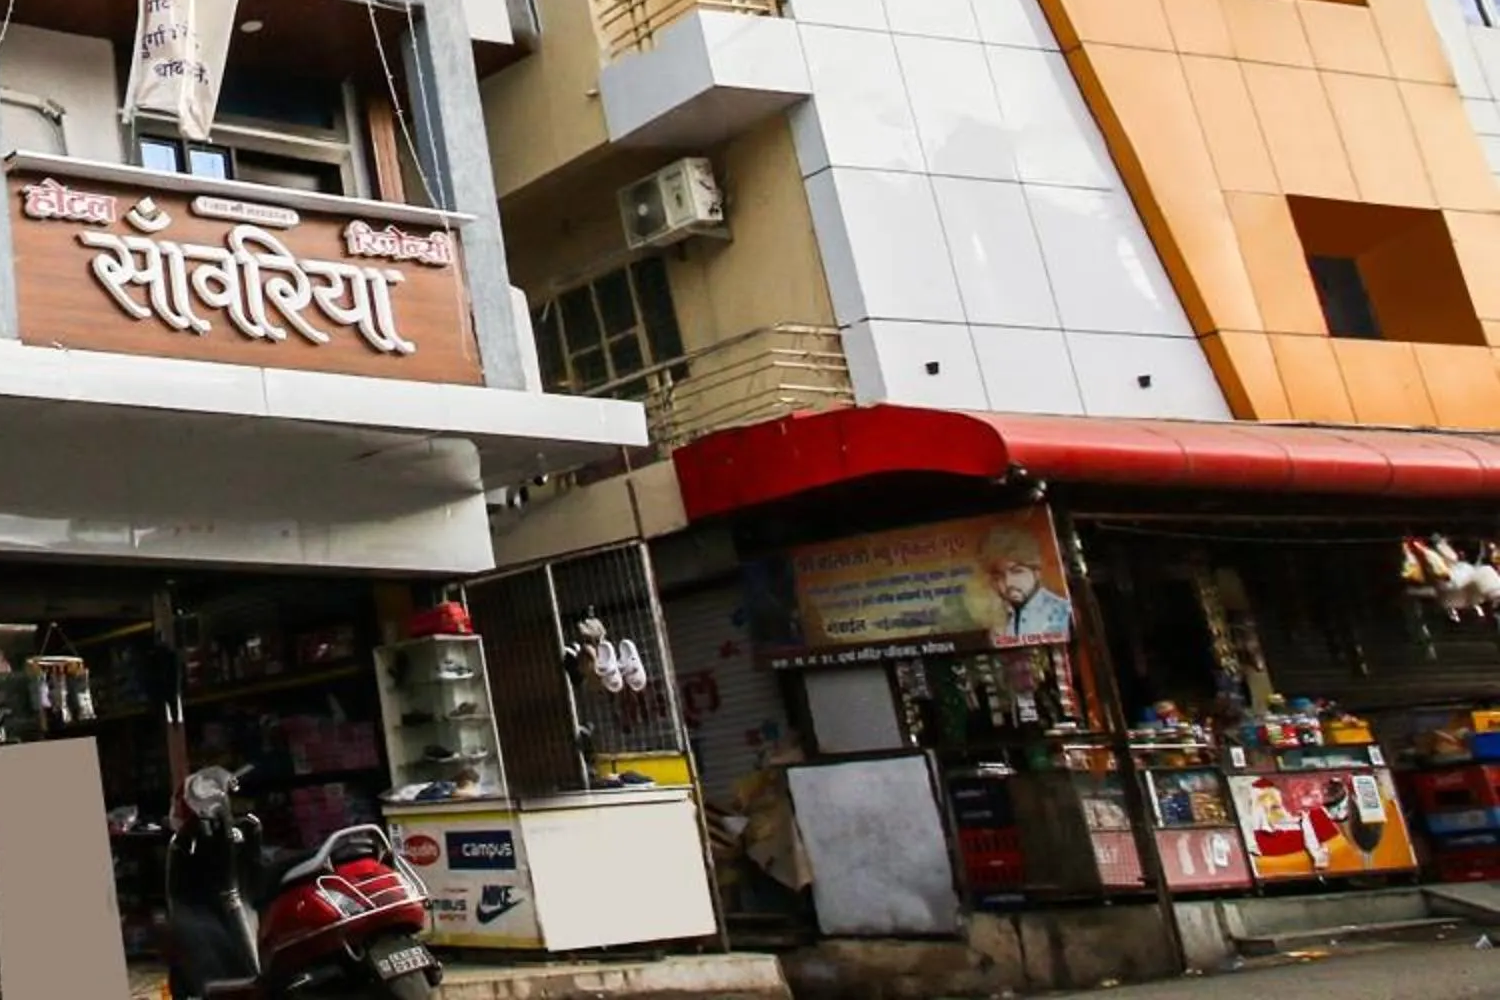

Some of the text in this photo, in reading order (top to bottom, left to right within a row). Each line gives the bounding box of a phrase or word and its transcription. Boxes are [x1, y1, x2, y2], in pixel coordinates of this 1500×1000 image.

[23, 178, 117, 223] होटल
[461, 842, 513, 860] campus
[481, 884, 516, 906] NIKE
